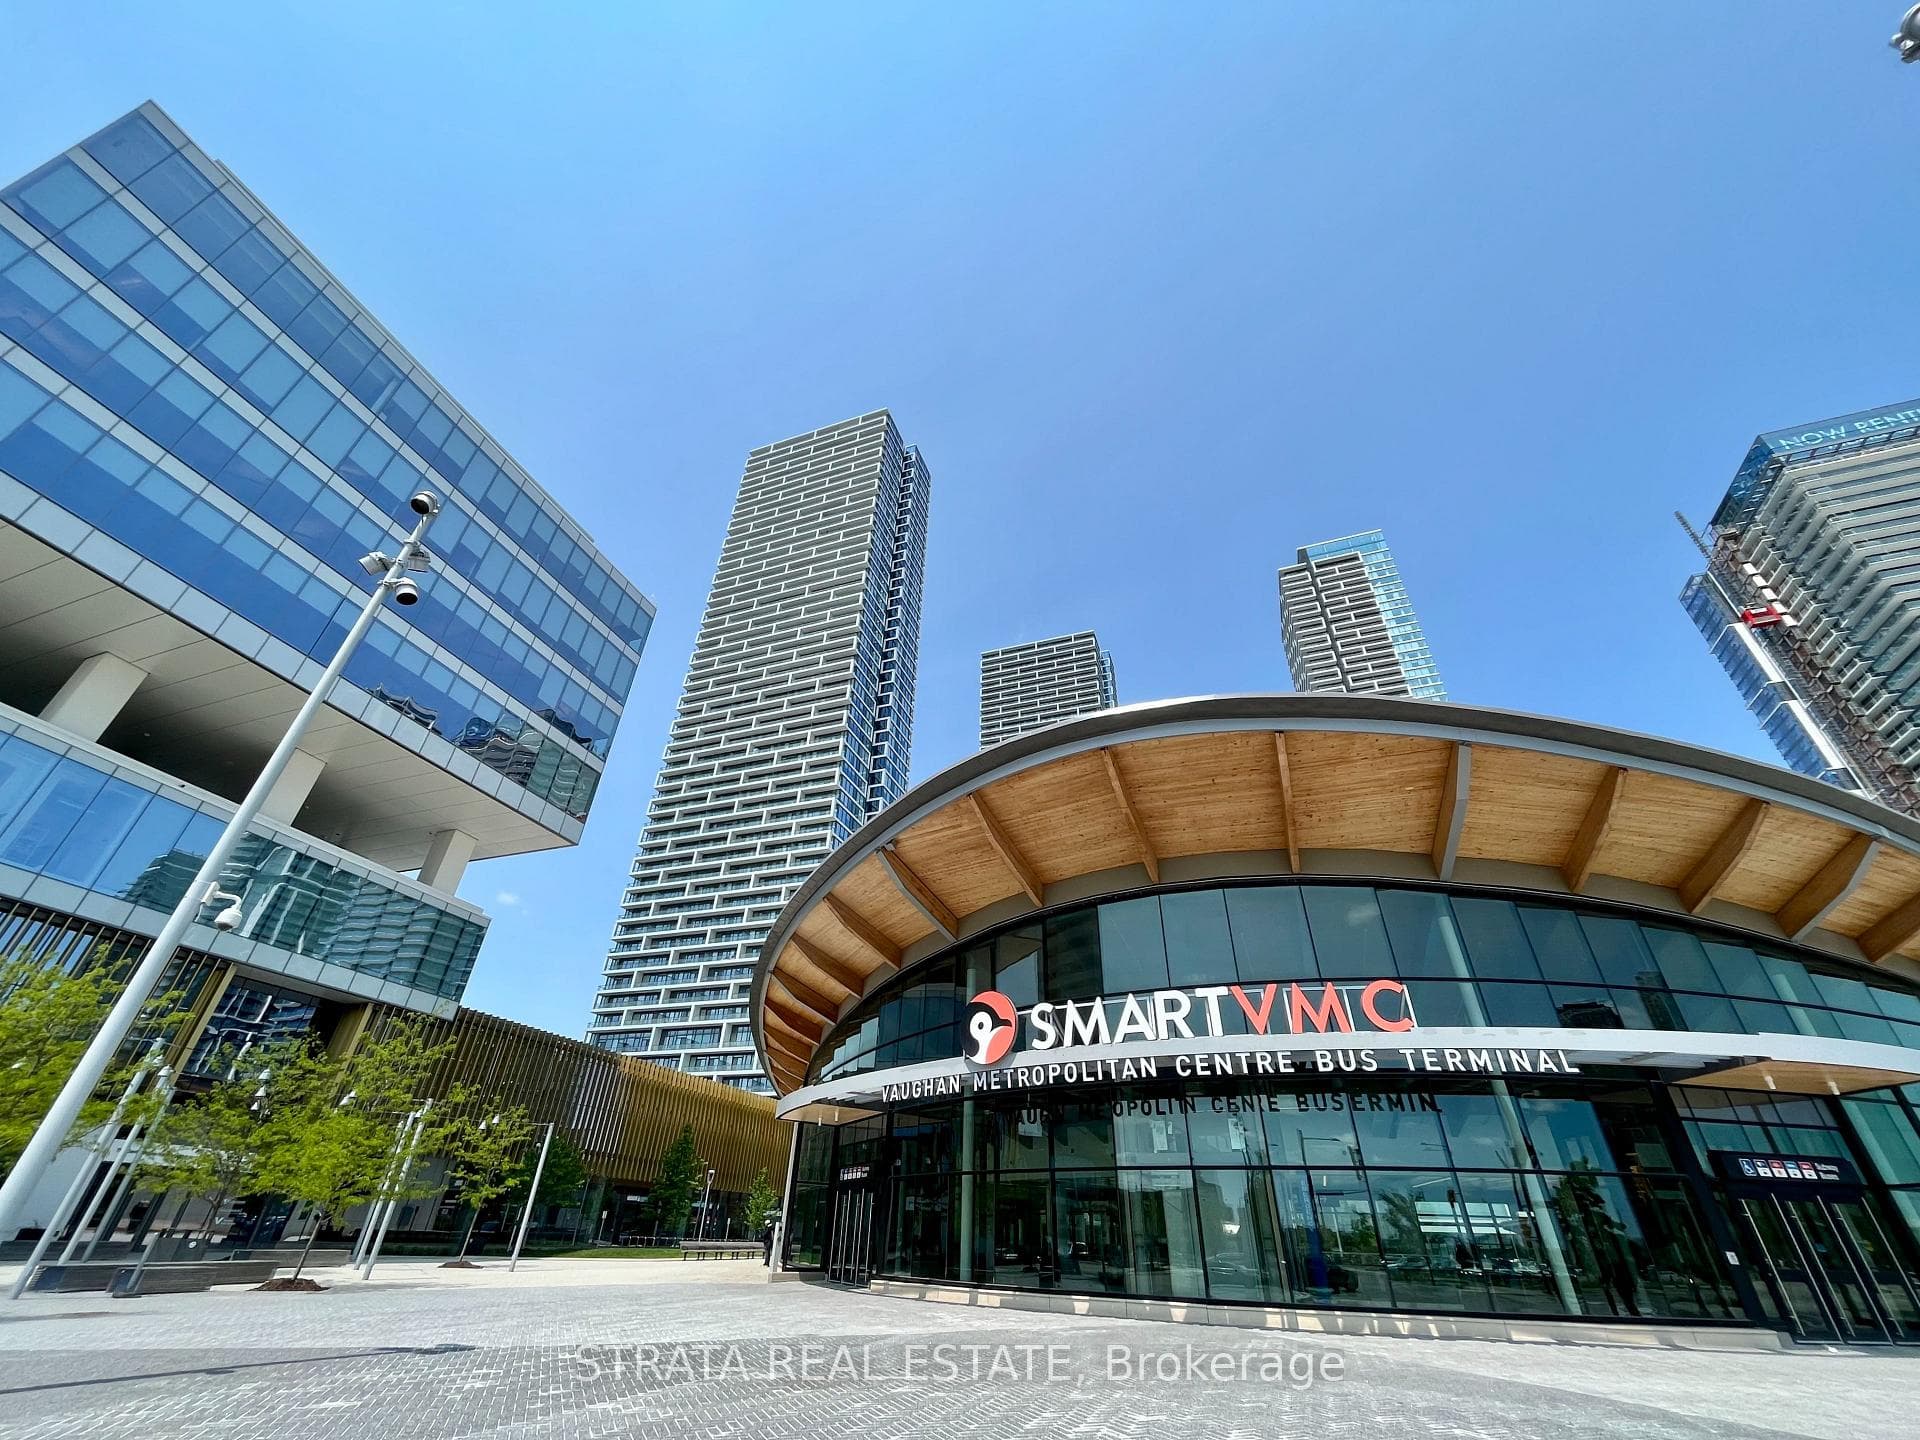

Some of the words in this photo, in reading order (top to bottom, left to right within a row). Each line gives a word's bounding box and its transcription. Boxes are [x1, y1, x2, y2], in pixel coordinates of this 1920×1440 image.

[1779, 425, 1846, 449] NOW
[882, 1074, 961, 1103] VAUGHAN
[973, 1056, 1157, 1091] METROPOLITAN
[1176, 1050, 1296, 1078] CENTRE
[1316, 1049, 1380, 1073] BUS
[1399, 1048, 1581, 1074] TERMINAL
